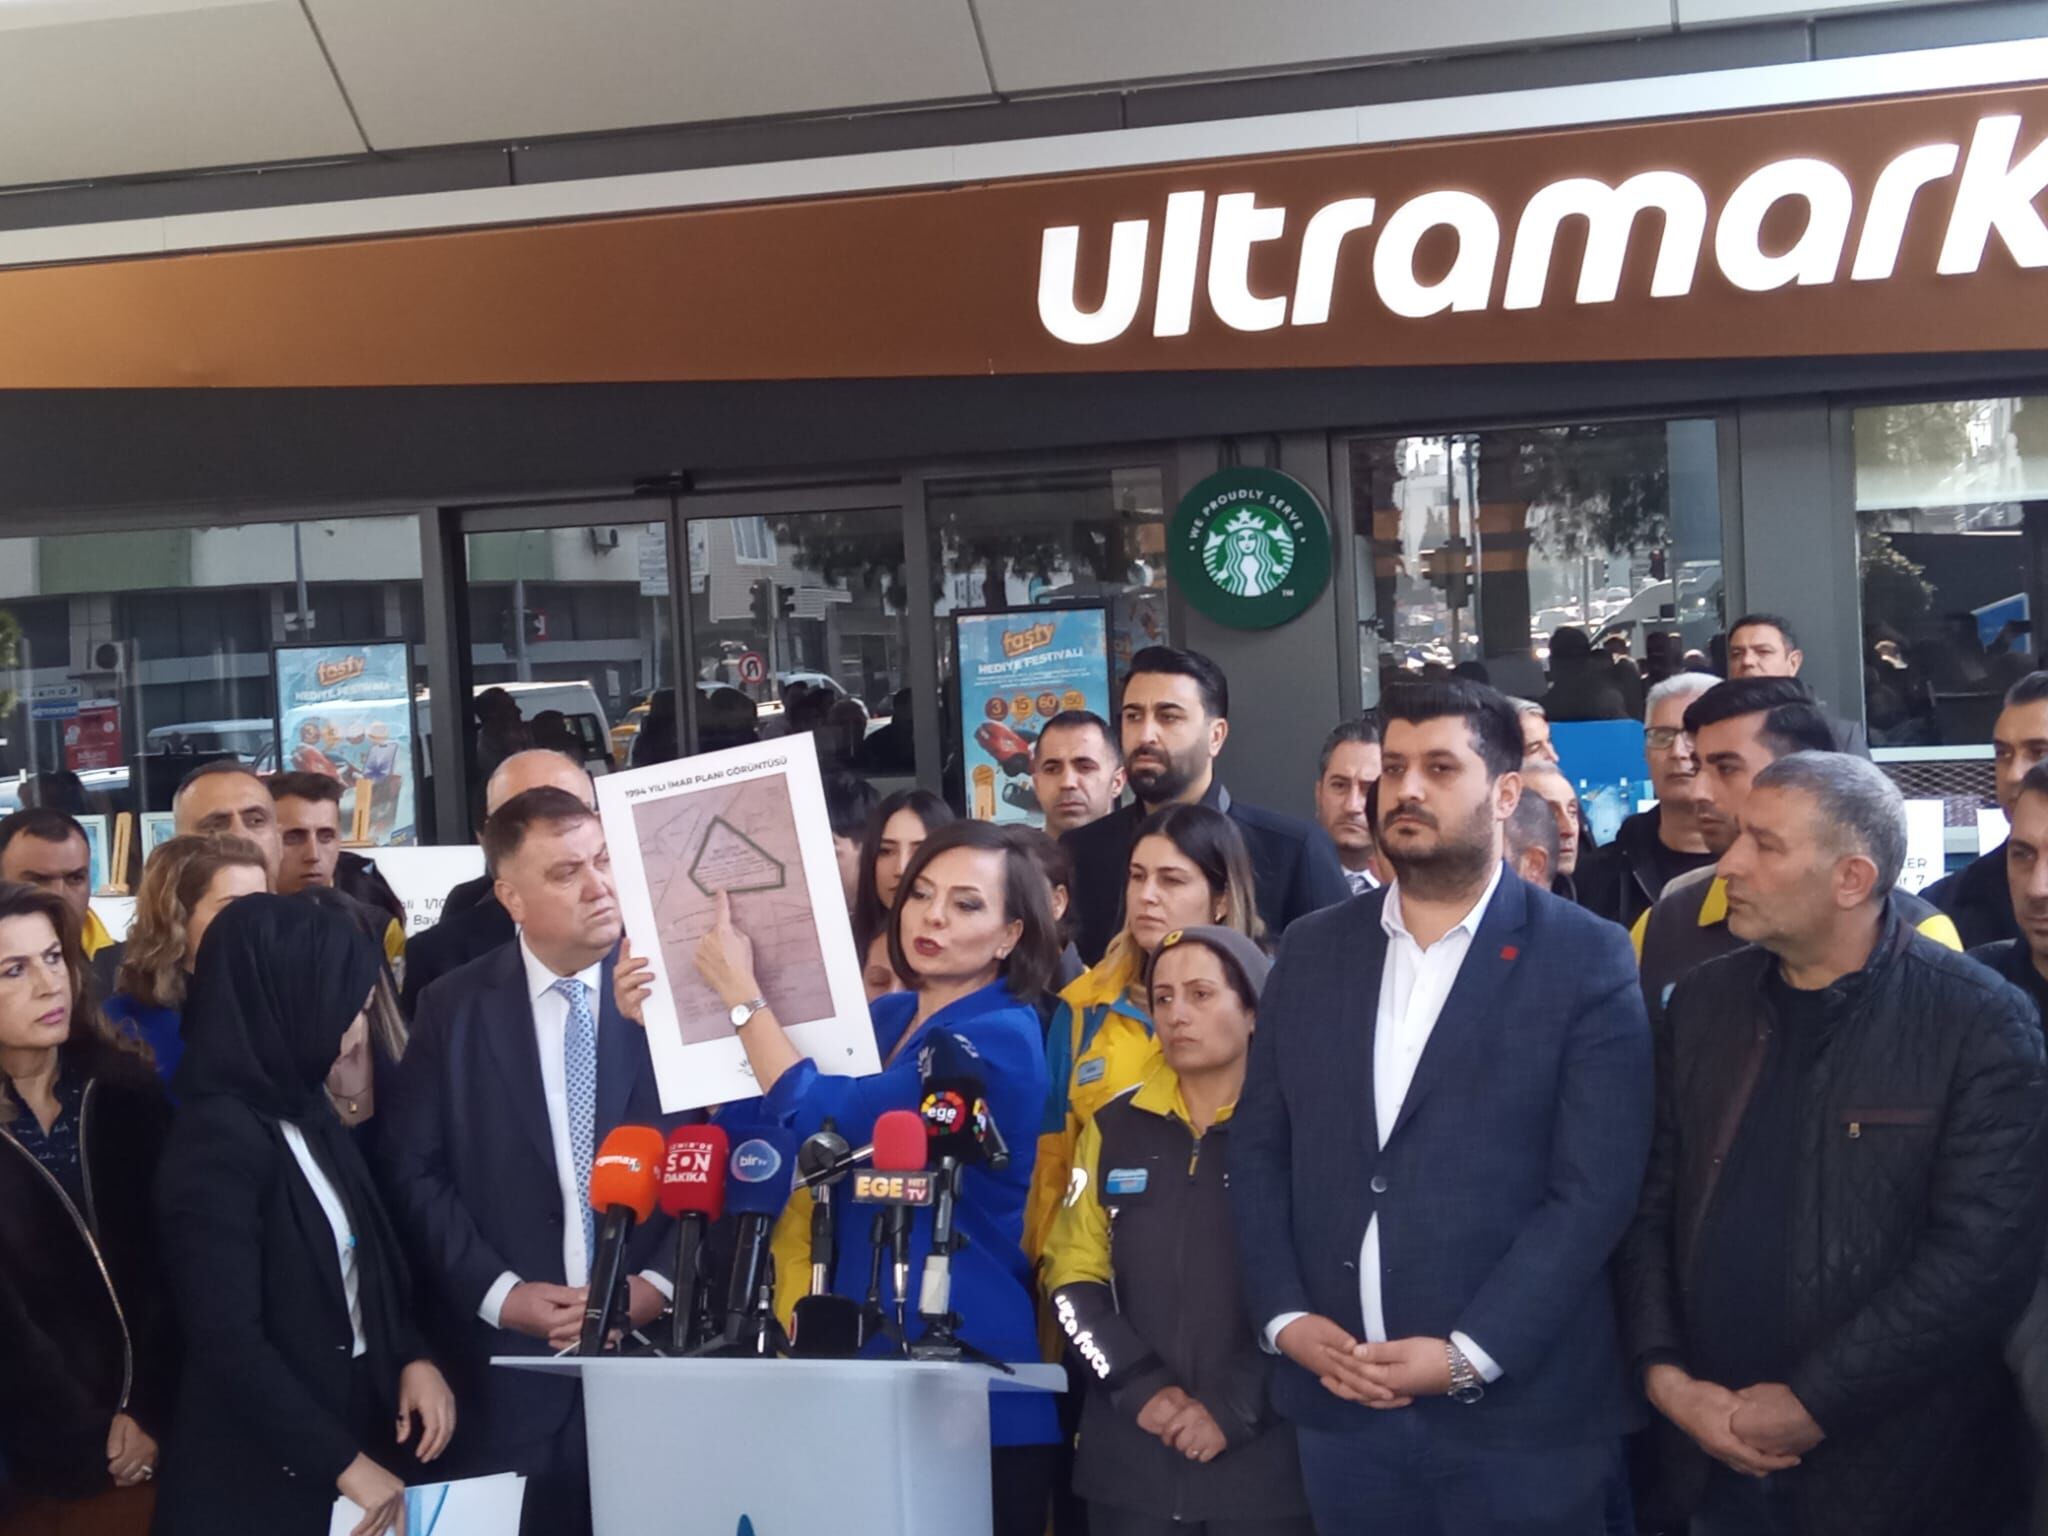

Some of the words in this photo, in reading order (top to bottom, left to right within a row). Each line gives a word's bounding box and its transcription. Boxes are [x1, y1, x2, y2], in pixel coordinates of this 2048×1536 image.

[1189, 518, 1204, 539] WE
[1202, 489, 1264, 516] PROUDLY
[1269, 495, 1304, 530] SERVE
[992, 699, 1003, 714] 3
[1015, 698, 1030, 711] 15
[855, 1175, 904, 1198] EGE
[908, 1188, 927, 1200] TV
